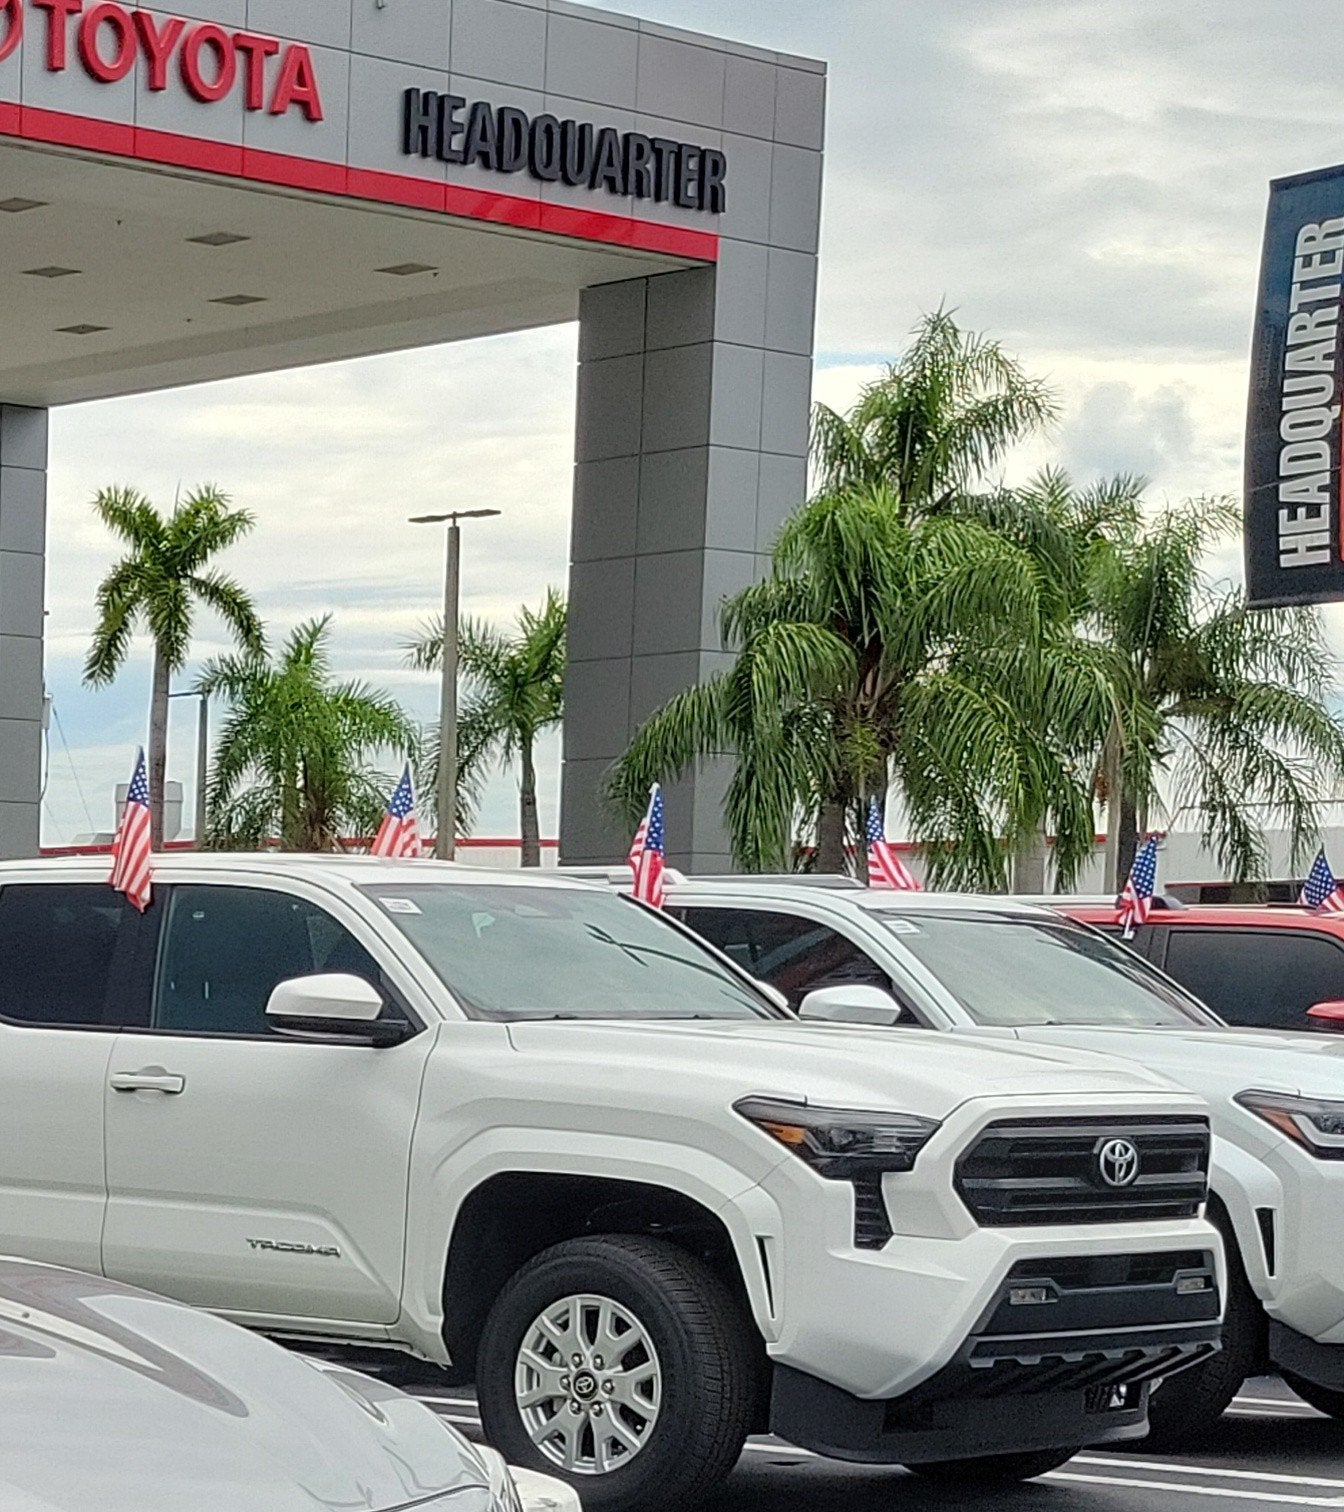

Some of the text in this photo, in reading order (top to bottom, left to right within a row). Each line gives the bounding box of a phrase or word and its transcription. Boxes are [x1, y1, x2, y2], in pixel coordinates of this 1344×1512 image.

[33, 0, 324, 121] TOYOTA
[403, 87, 727, 213] HEADQUARTER
[1278, 216, 1344, 569] HEADQUARTER
[245, 1237, 341, 1259] TACOMA
